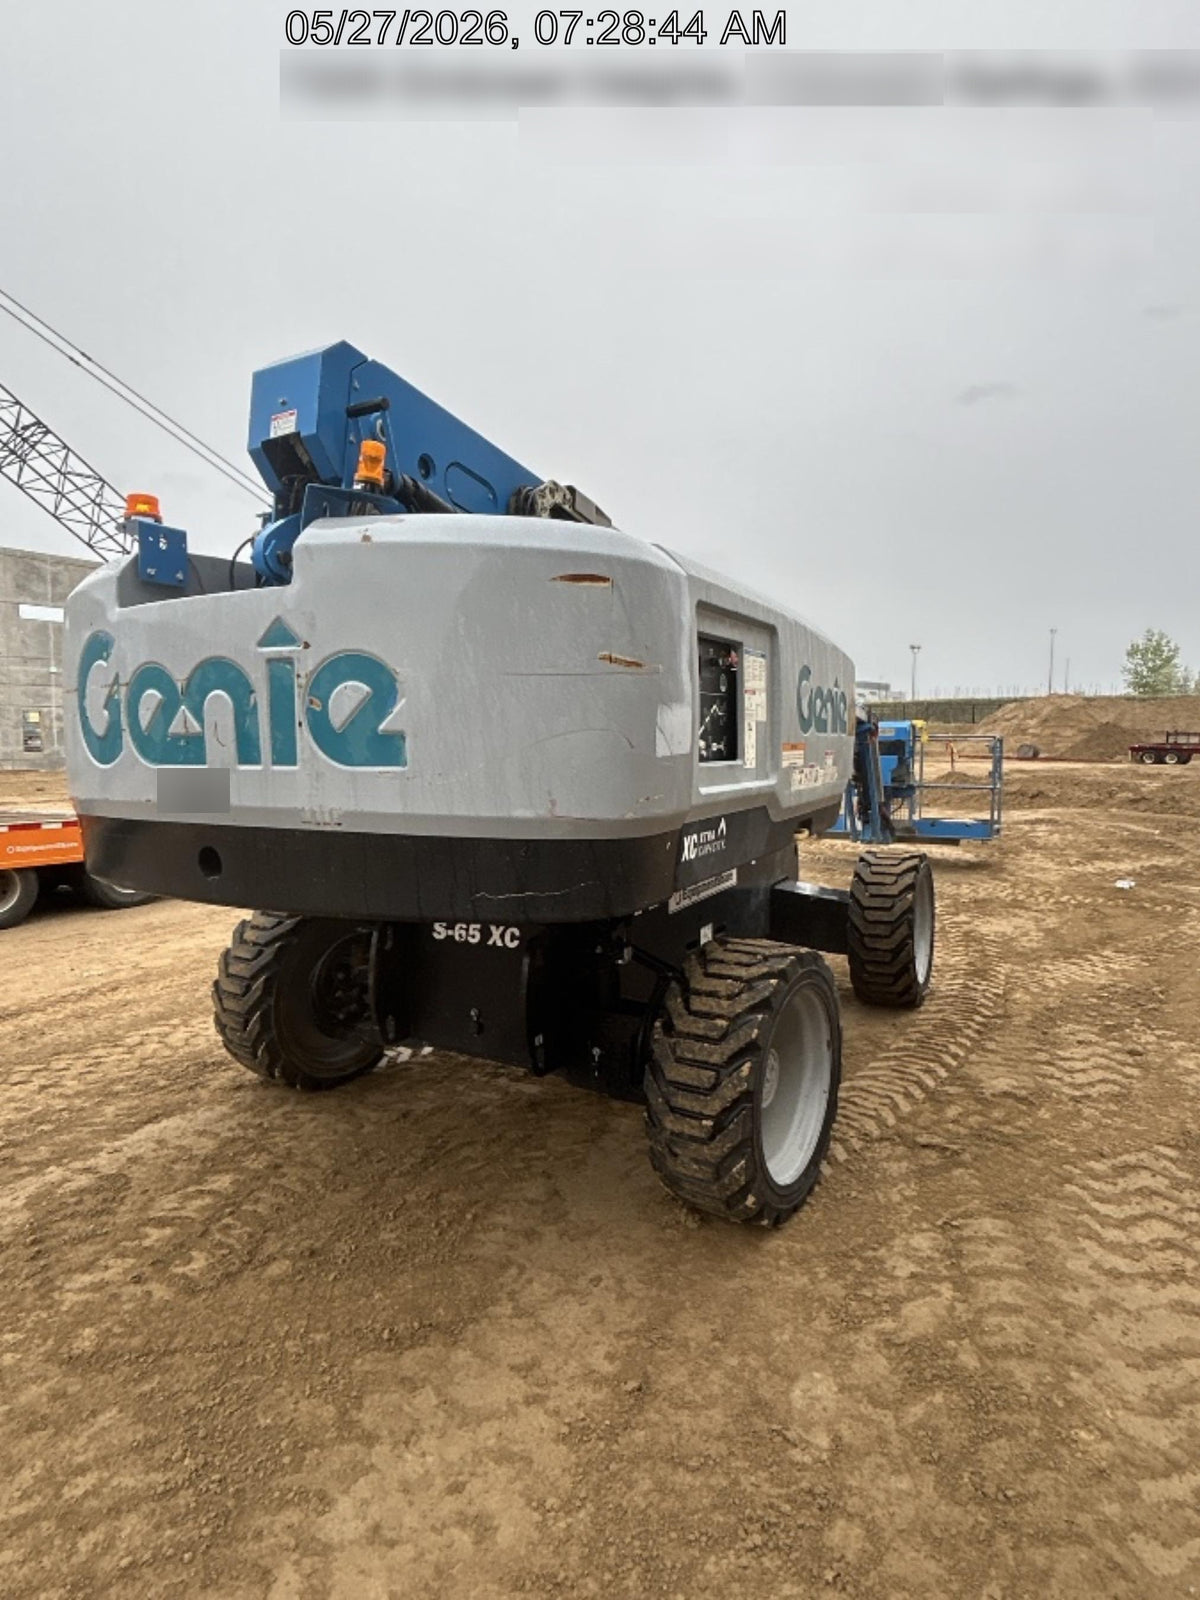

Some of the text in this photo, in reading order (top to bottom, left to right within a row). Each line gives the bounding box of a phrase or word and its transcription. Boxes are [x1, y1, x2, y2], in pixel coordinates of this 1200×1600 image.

[77, 614, 409, 770] Genie
[797, 663, 848, 737] Genie
[680, 833, 698, 862] XC
[432, 921, 521, 949] S-65 XC
